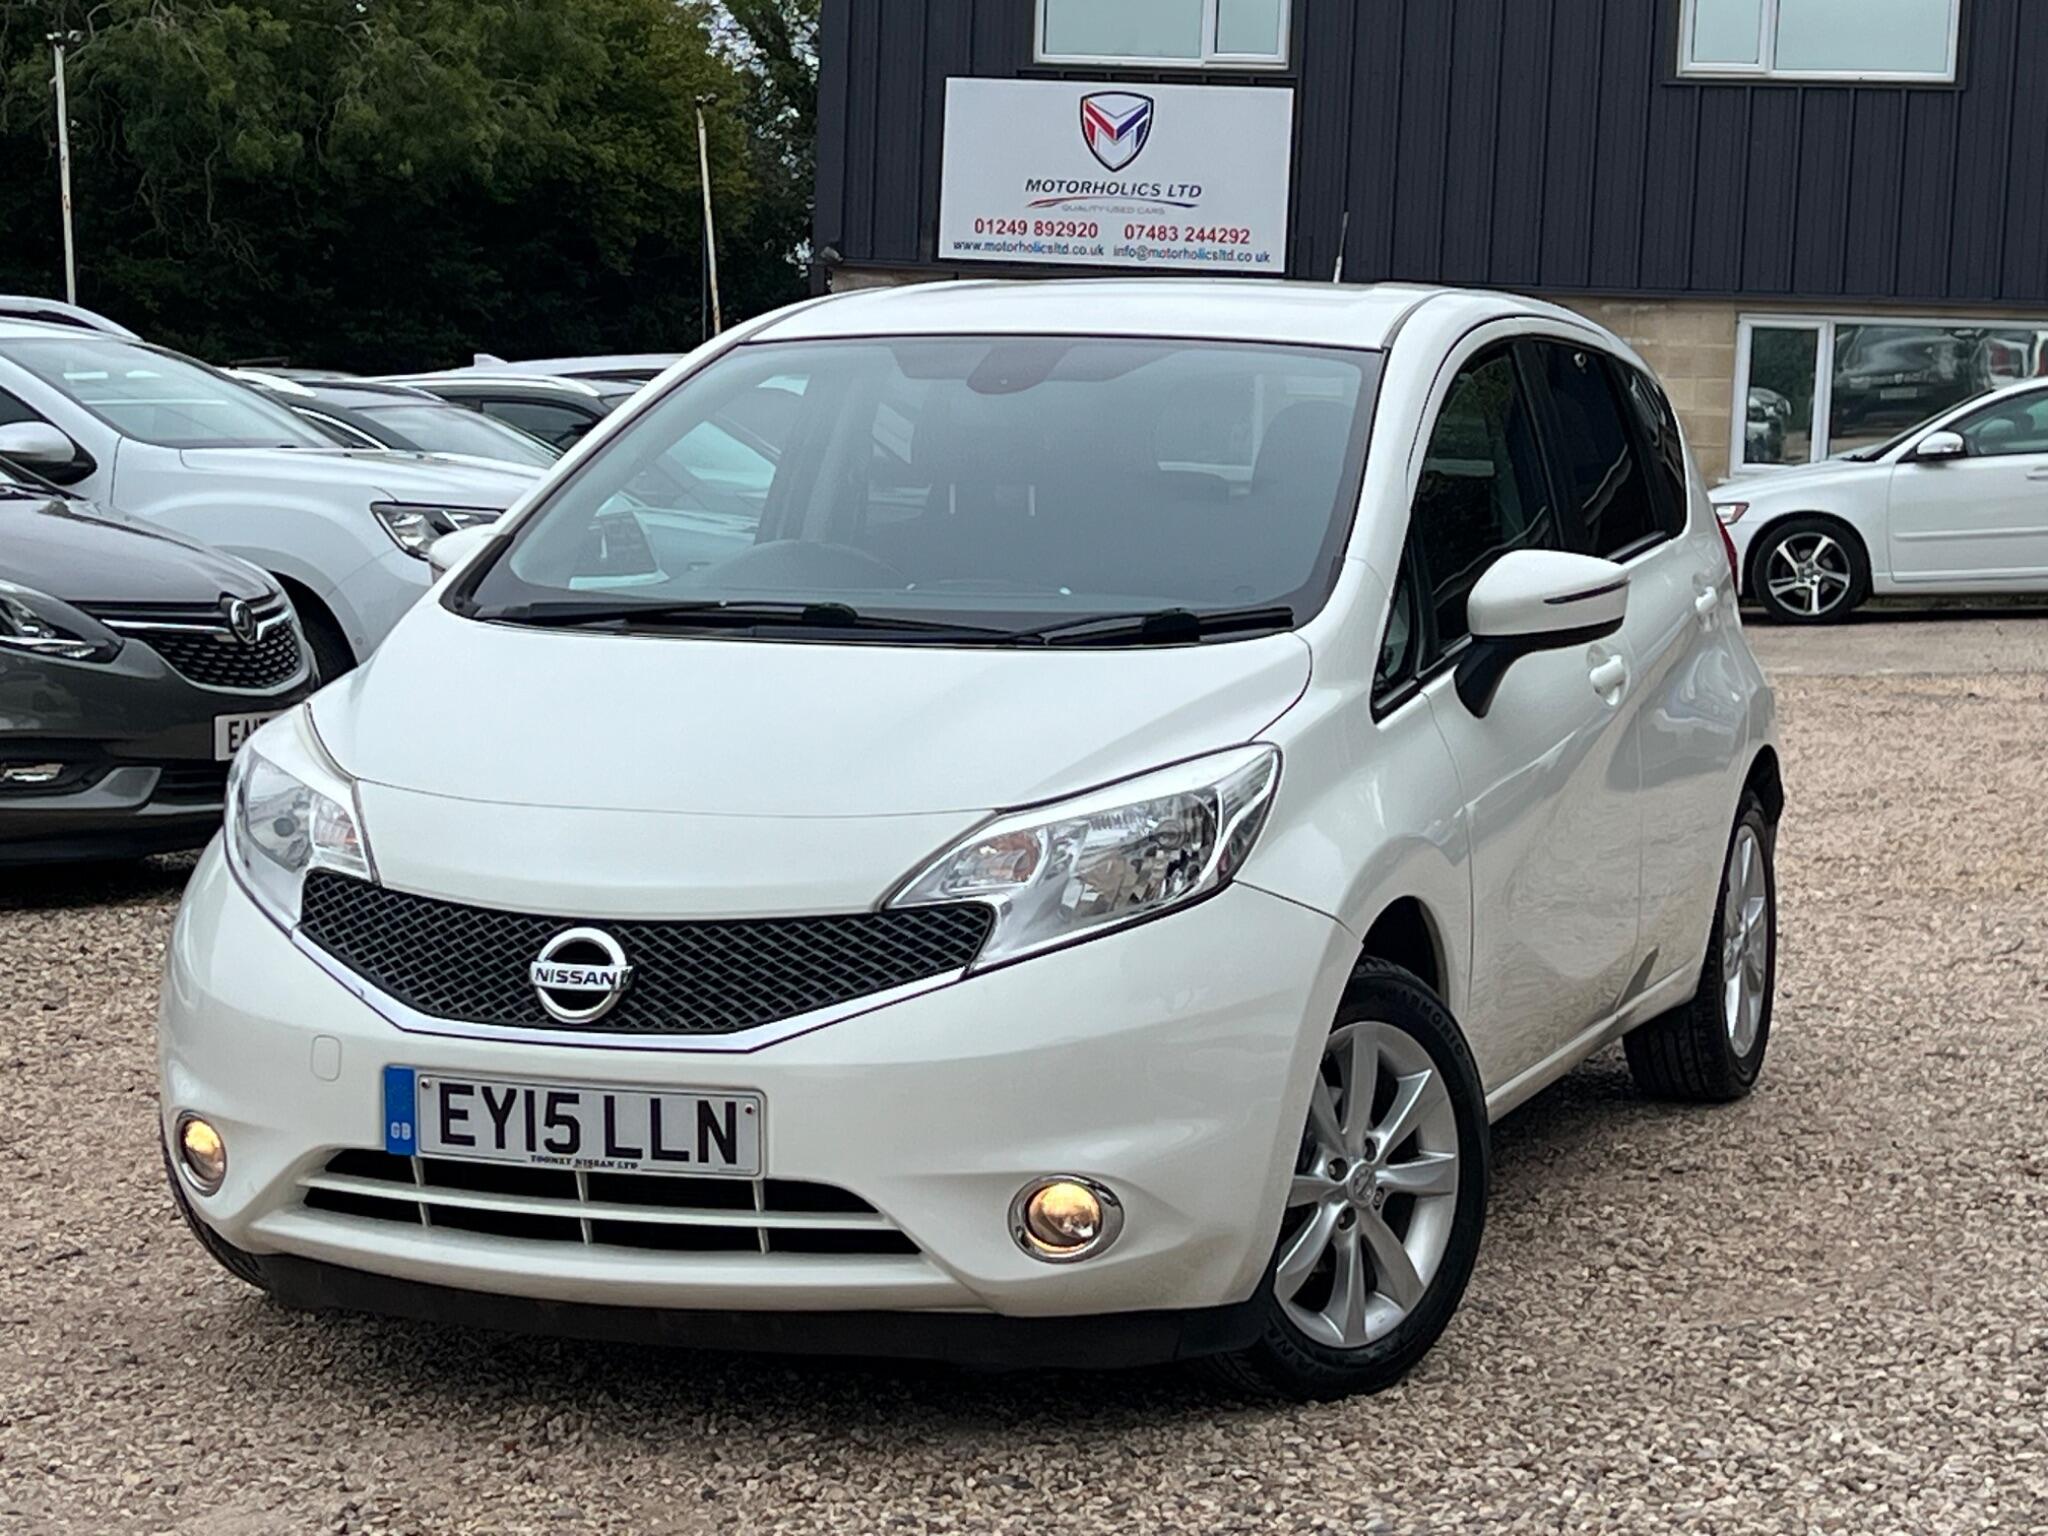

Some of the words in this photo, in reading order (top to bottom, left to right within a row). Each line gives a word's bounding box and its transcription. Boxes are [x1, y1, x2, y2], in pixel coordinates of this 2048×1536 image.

[1025, 179, 1161, 198] MOTORHOLICS
[1167, 183, 1202, 199] LTD
[974, 218, 1028, 237] 01249
[1033, 220, 1099, 239] 892920
[1124, 223, 1179, 242] 07483
[1184, 226, 1251, 245] 244292
[953, 239, 1105, 257] www.motorholicsltd.co.uk
[535, 967, 618, 986] NISSAN
[390, 1121, 412, 1141] GB
[439, 1082, 581, 1155] EY15
[604, 1094, 737, 1165] LLN
